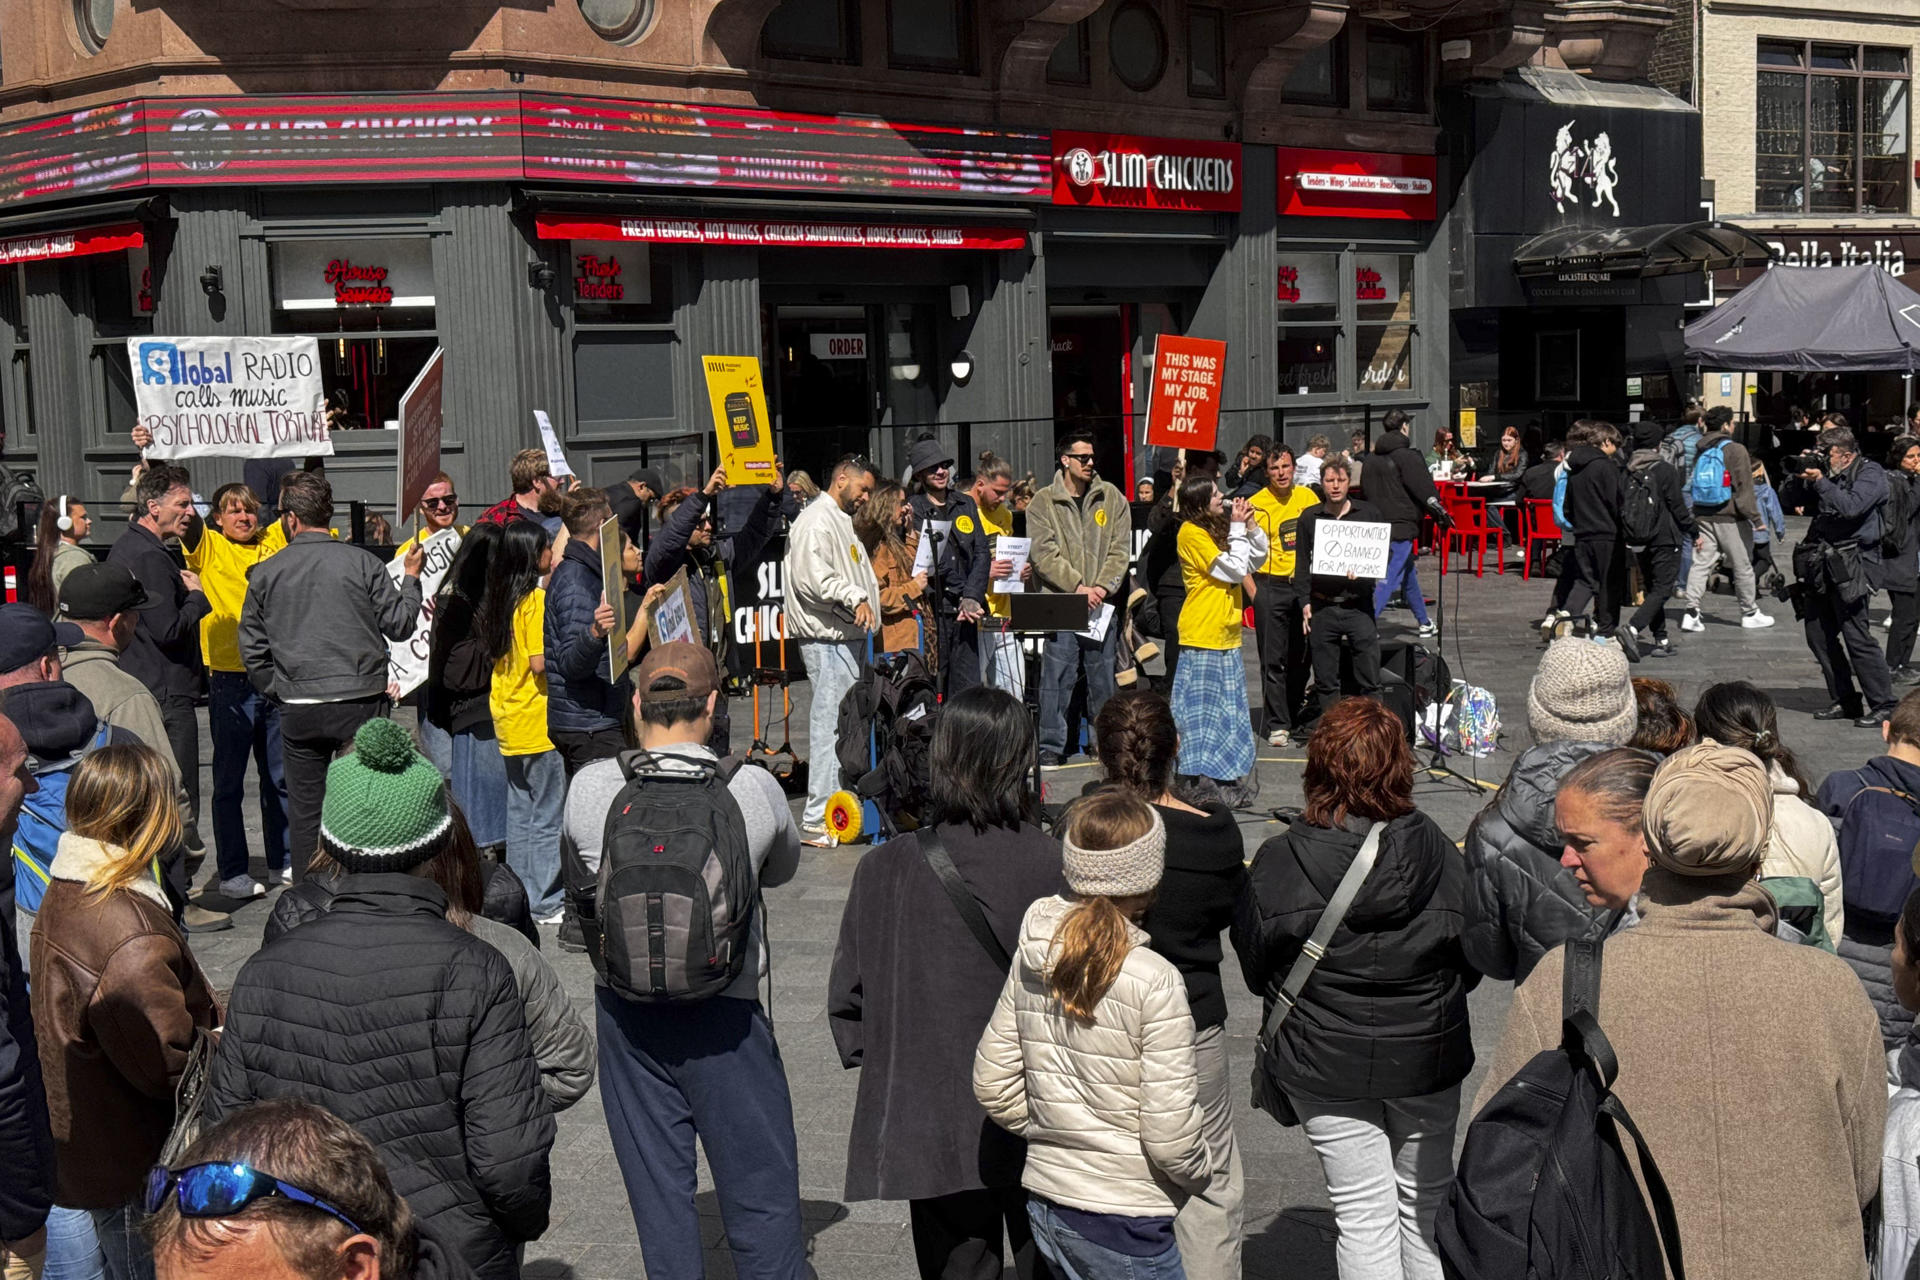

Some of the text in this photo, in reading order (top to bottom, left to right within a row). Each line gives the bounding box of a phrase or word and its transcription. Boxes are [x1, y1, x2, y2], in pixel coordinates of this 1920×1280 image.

[1103, 151, 1234, 194] SLIM CHICKENS
[1329, 176, 1345, 188] Wings
[621, 220, 964, 247] FRESH TENDERS, HOT WINGS, CHICKEN SANDWICHES, HOUSE SAUCES, SHAKES
[1840, 239, 1905, 277] Italia
[324, 259, 388, 284] House
[1559, 273, 1611, 283] LEICESTER SQUARE
[335, 281, 394, 303] Sauces
[576, 277, 624, 300] Tenders
[829, 338, 864, 356] ORDER
[242, 352, 313, 381] RADIO
[1165, 352, 1217, 370] THIS WAS
[1161, 367, 1217, 388] MY STAGE,
[1361, 361, 1406, 385] order
[175, 382, 287, 408] calls music
[1164, 383, 1209, 402] MY JOB,
[1173, 400, 1197, 417] MY
[263, 409, 332, 445] TORTURE
[412, 403, 433, 443] STOP
[733, 423, 750, 432] MUSIC
[1167, 416, 1198, 434] JOY.
[408, 416, 438, 470] KILLING
[1322, 524, 1388, 540] OPPORTUNITIES
[1343, 542, 1381, 560] BANNED
[1318, 560, 1335, 572] FOR
